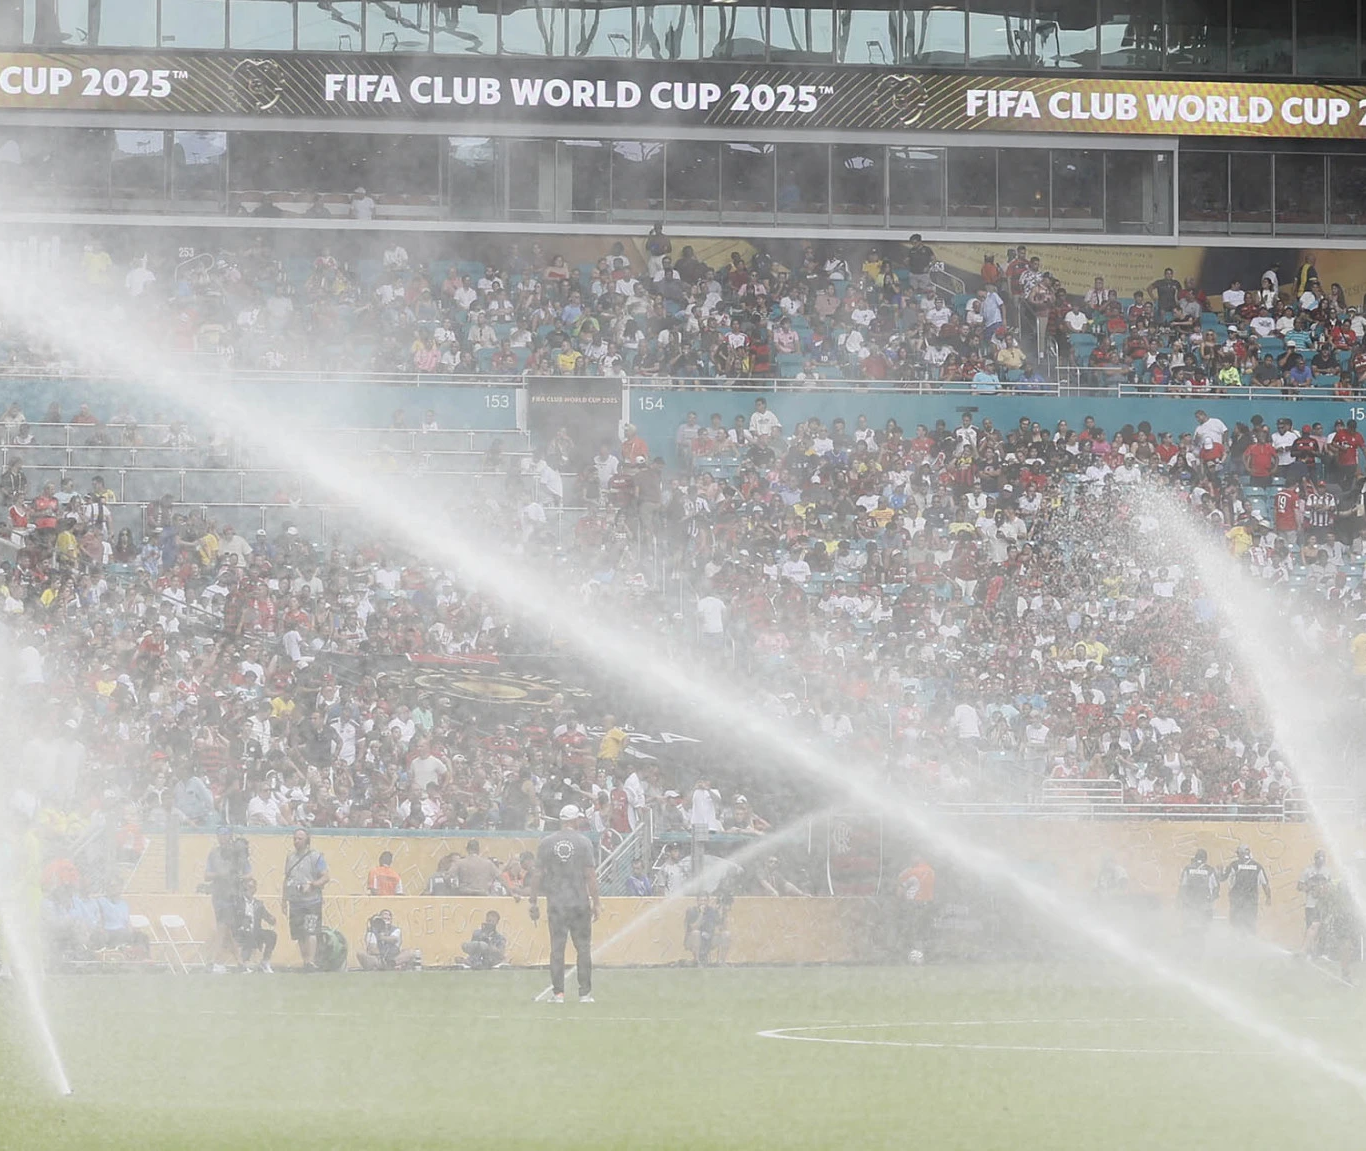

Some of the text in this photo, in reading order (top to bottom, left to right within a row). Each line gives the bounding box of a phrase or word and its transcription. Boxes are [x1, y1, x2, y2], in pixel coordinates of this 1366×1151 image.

[0, 67, 72, 94] CUP
[326, 74, 401, 102] FIFA
[410, 76, 500, 104] CLUB
[511, 79, 641, 107] WORLD
[650, 82, 720, 109] CUP
[967, 90, 1040, 117] FIFA
[1049, 92, 1137, 120] CLUB
[1146, 94, 1273, 123] WORLD
[1281, 97, 1350, 125] CUP
[485, 395, 509, 408] 153
[638, 397, 664, 410] 154
